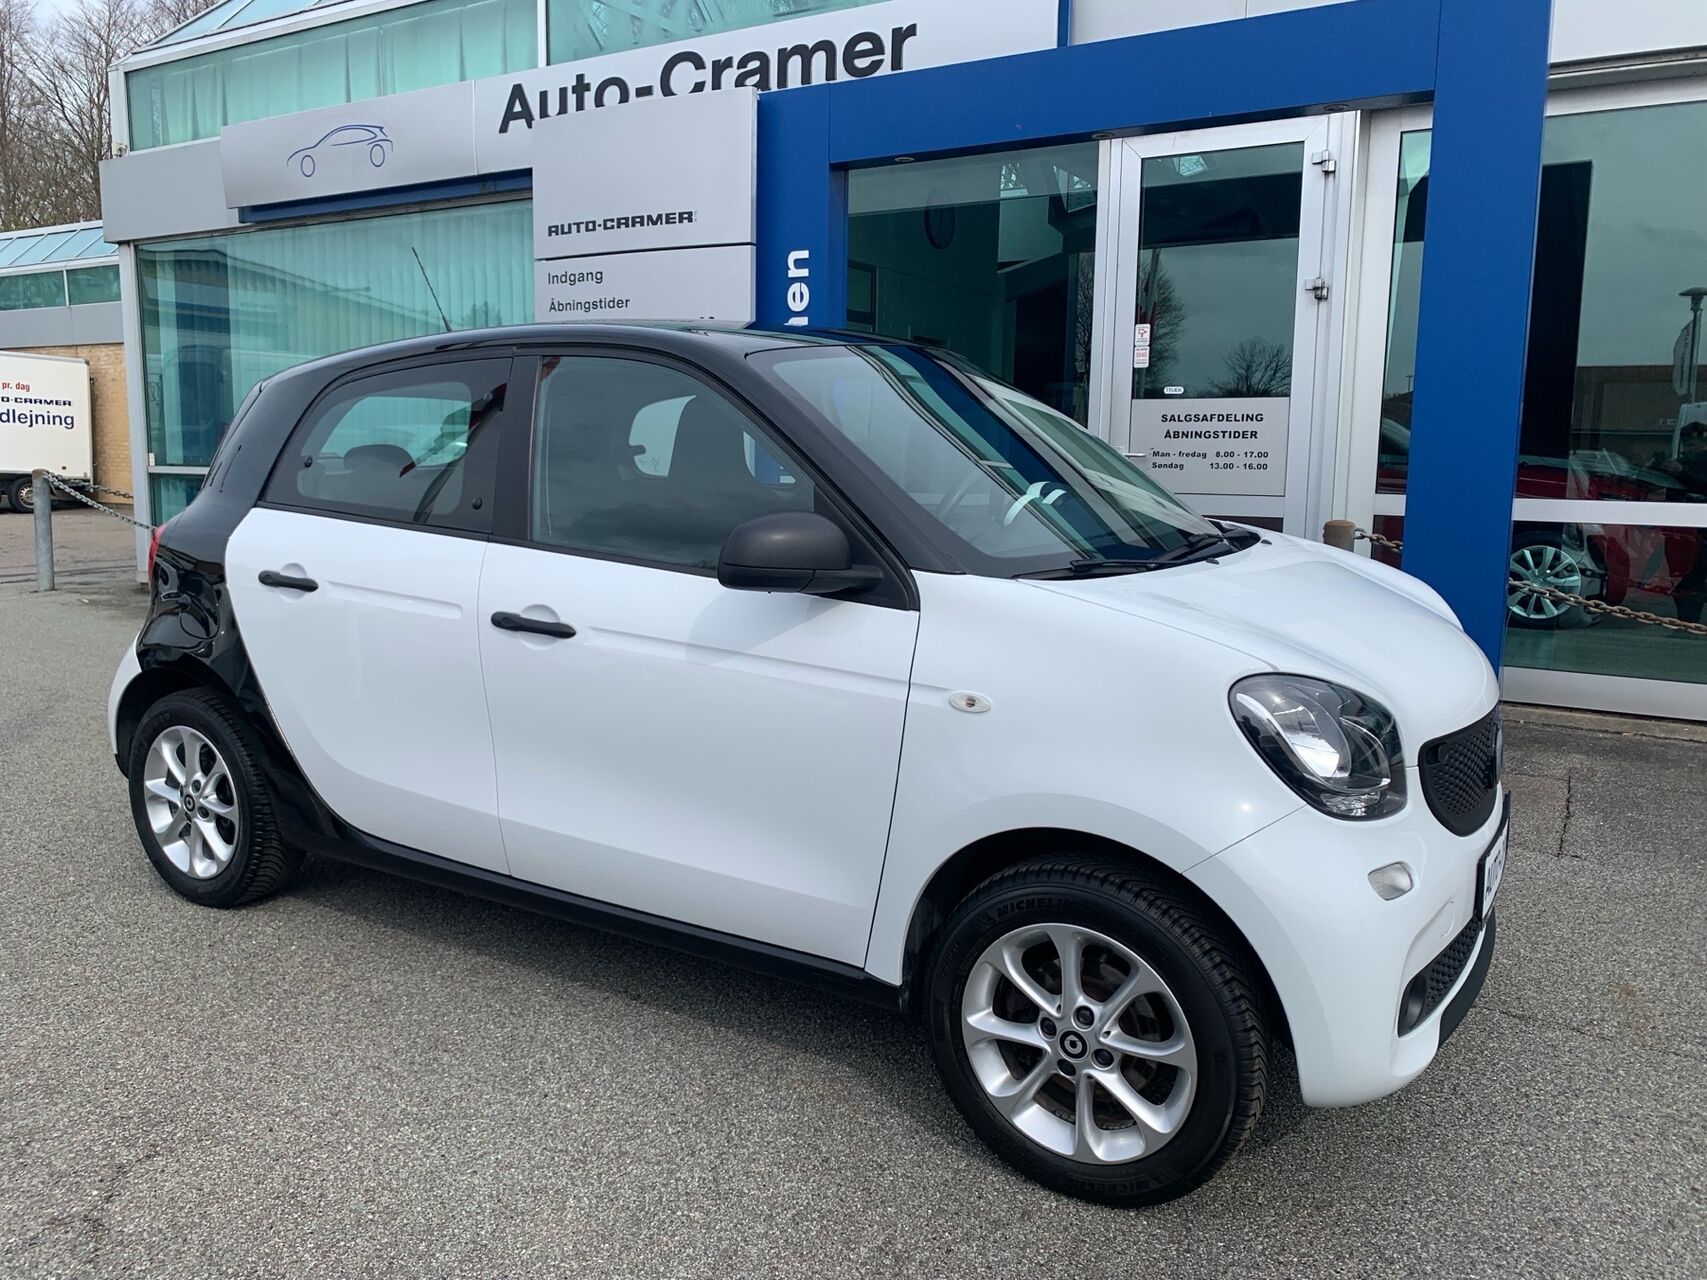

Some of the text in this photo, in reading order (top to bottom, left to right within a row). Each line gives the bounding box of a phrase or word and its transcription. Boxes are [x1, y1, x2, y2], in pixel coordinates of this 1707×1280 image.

[499, 22, 918, 134] Auto-Cramer
[547, 210, 694, 237] AUTO-CRAMER
[547, 270, 604, 287] Indgang
[548, 297, 631, 313] Åbningstider
[2, 381, 31, 393] pr. dag
[0, 408, 75, 430] dlejning
[1161, 413, 1265, 423] SALGSAFDELING
[1164, 428, 1259, 440] ÅBNINGSTIDER
[1152, 451, 1171, 459] Man
[1178, 450, 1208, 460] fredag
[1215, 451, 1236, 459] 8.00
[1244, 451, 1270, 459] 17.00
[1152, 462, 1185, 471] Søndag
[1209, 462, 1235, 471] 13.00
[1243, 462, 1269, 471] 16.00
